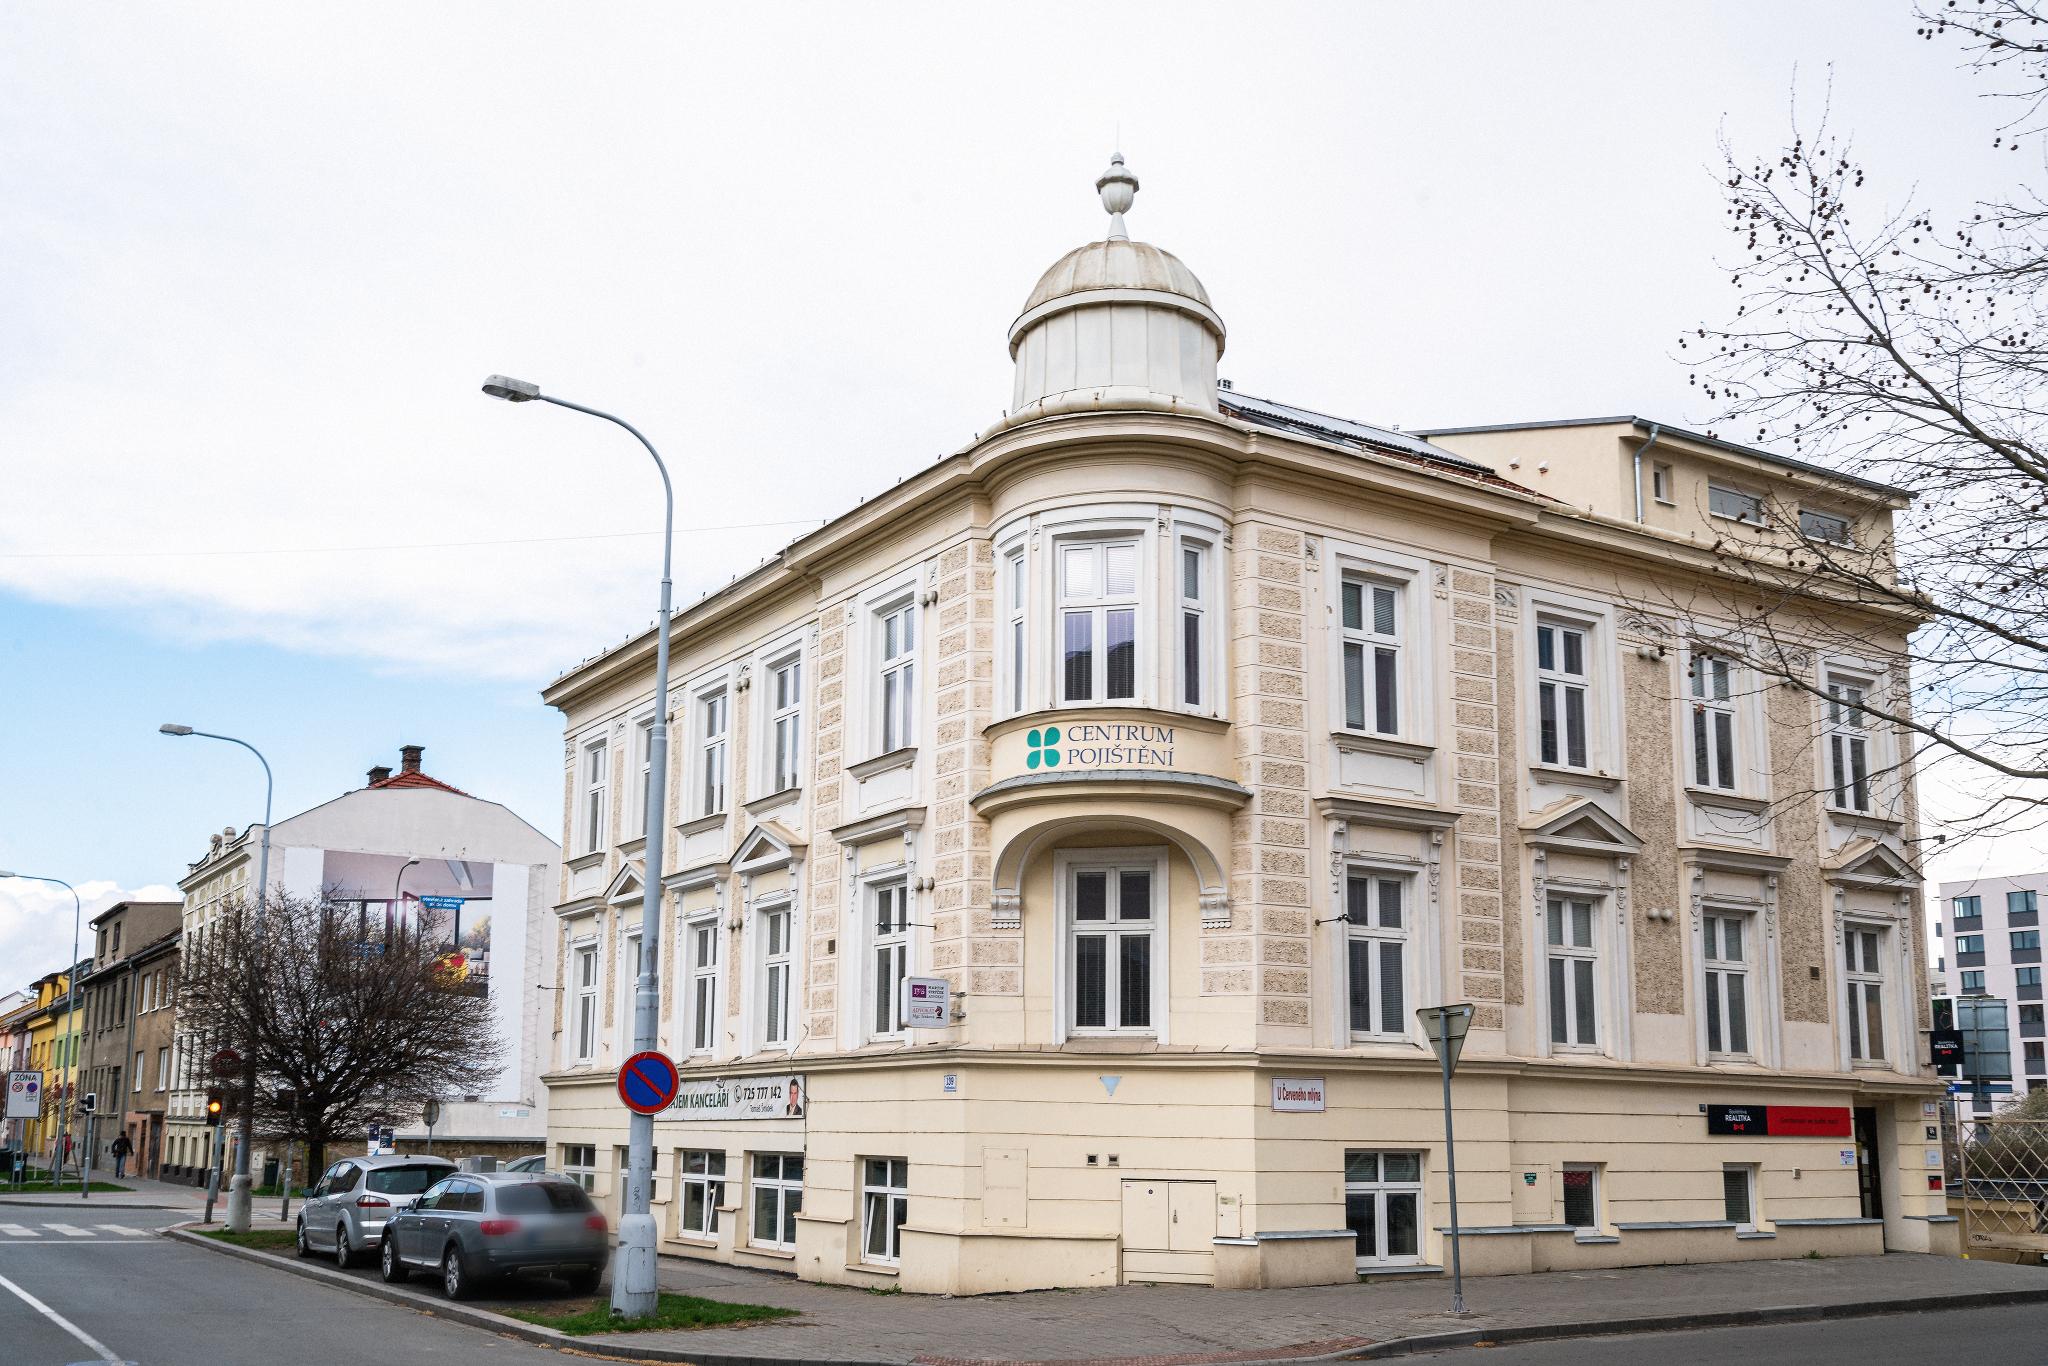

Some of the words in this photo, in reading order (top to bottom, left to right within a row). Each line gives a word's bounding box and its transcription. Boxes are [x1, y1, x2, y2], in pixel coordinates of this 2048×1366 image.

[1068, 725, 1174, 744] CENTRUM
[1067, 745, 1174, 767] POJIŠTĚNÍ
[690, 1089, 729, 1108] KANCELÁŘÍ
[743, 1087, 755, 1101] 725
[756, 1086, 769, 1100] 777
[770, 1086, 782, 1099] 142
[1277, 1086, 1282, 1101] U
[1725, 1114, 1752, 1122] REALITKA
